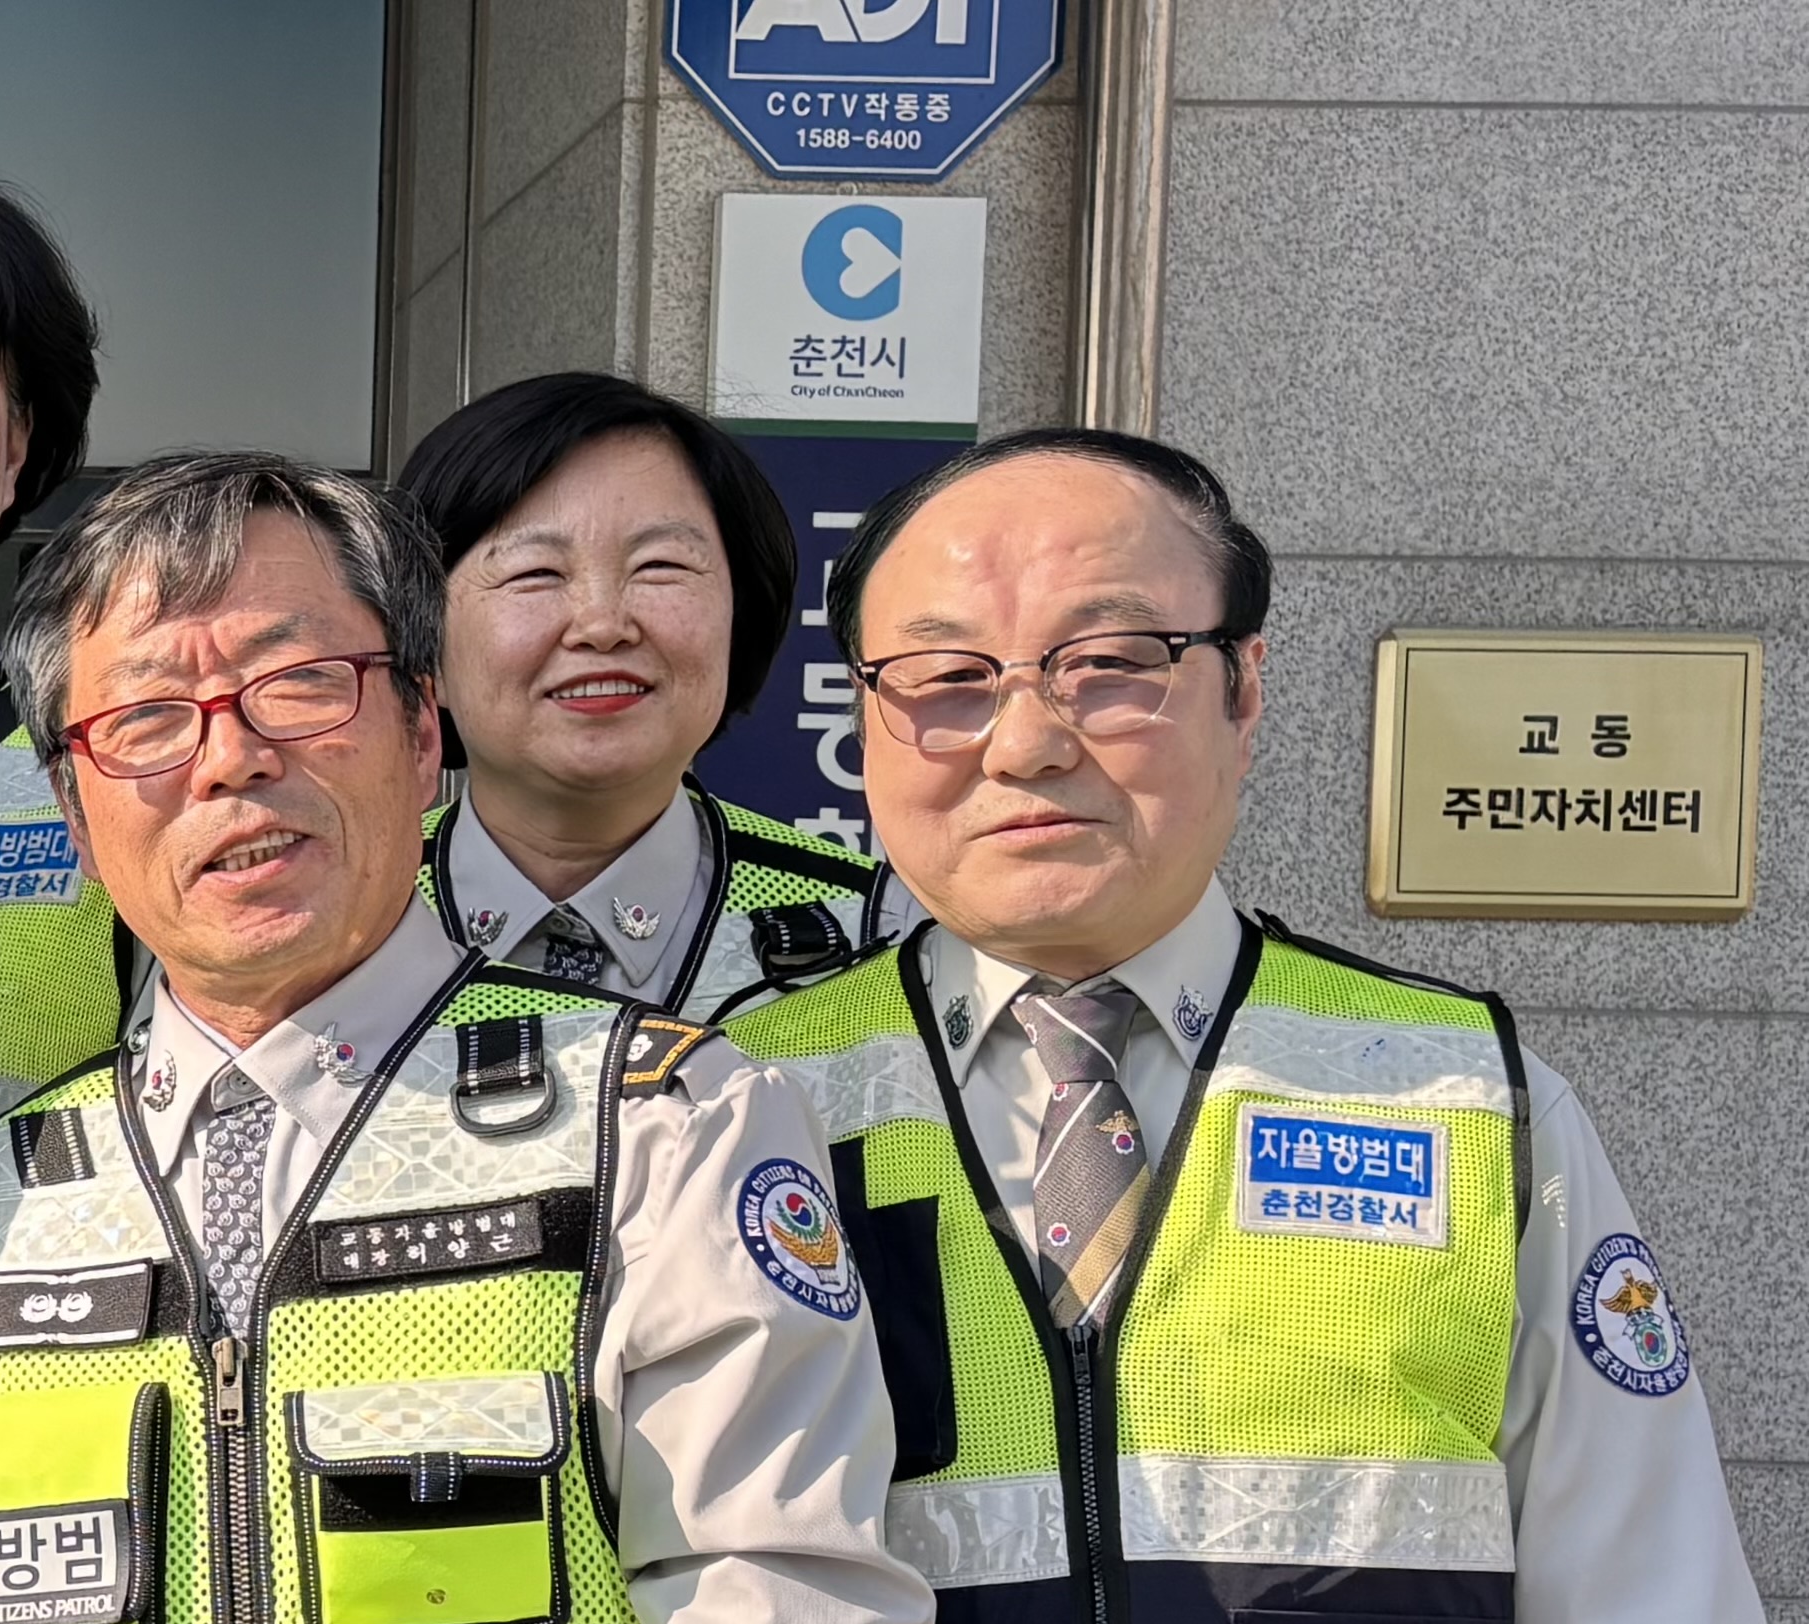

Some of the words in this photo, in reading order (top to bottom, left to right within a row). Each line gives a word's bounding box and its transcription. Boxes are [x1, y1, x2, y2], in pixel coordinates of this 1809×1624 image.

[766, 92, 951, 123] CCTV작동중
[796, 128, 922, 151] 1588-6400
[789, 334, 906, 380] 춘천시
[790, 384, 816, 400] City
[817, 384, 831, 397] of
[1442, 786, 1702, 834] 주민자치센터
[1257, 1127, 1426, 1194] 자율방범대
[744, 1193, 764, 1238] KOREA
[1260, 1188, 1419, 1230] 춘천경찰서
[1575, 1272, 1600, 1326] KOREA
[53, 1593, 116, 1618] PATROL
